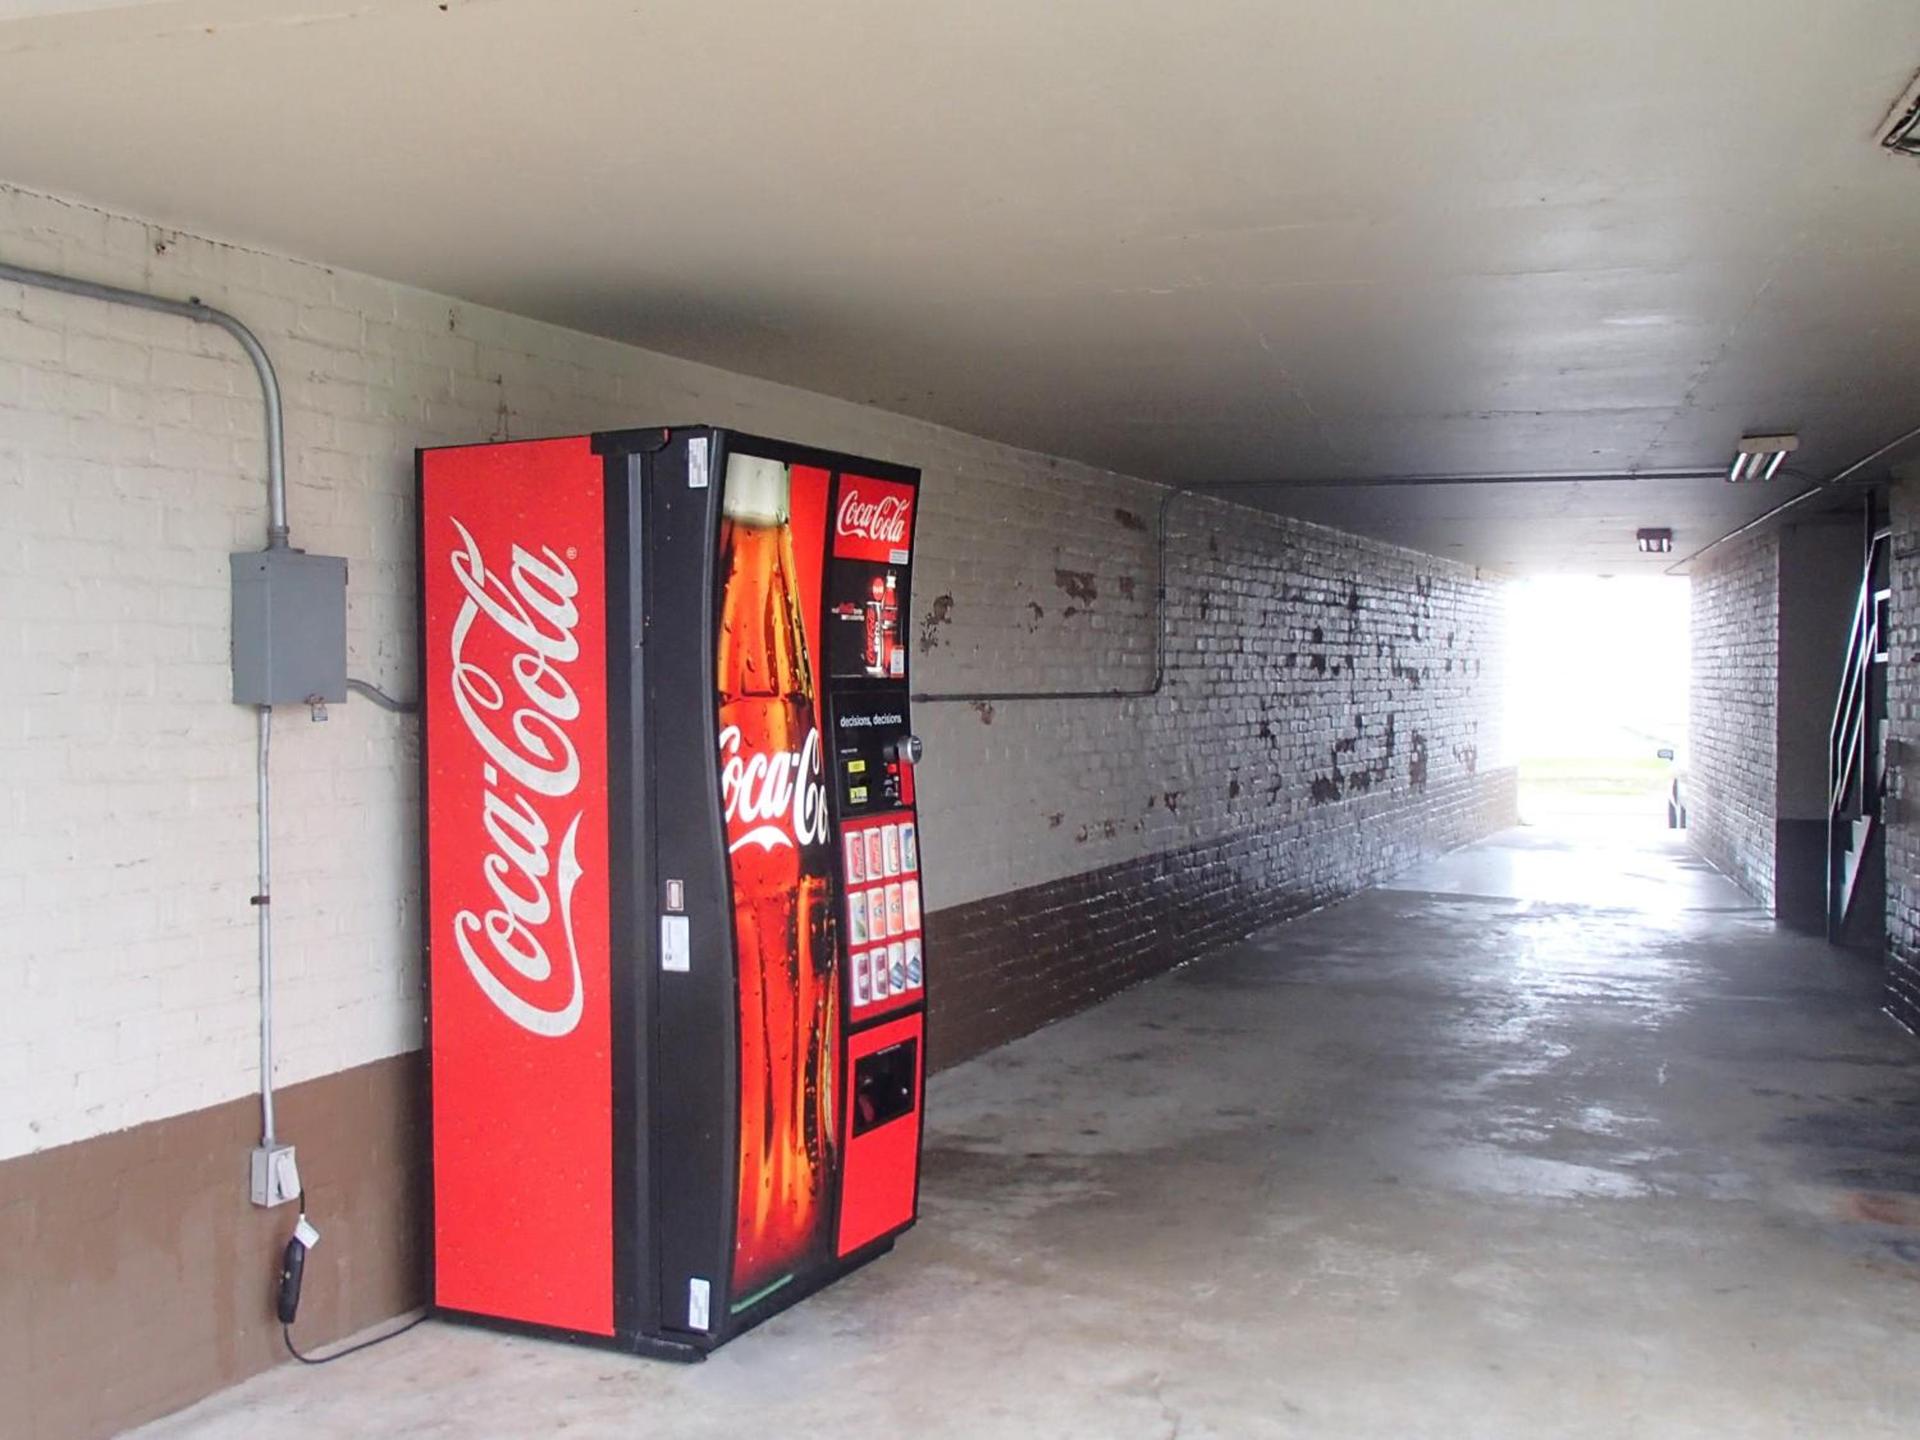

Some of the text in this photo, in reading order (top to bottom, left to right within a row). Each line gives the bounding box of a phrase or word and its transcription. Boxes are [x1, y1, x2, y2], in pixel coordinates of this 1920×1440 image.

[837, 490, 910, 543] Coca-Cola
[840, 713, 902, 727] decisions, decisions
[450, 516, 583, 1037] Coca-Cola
